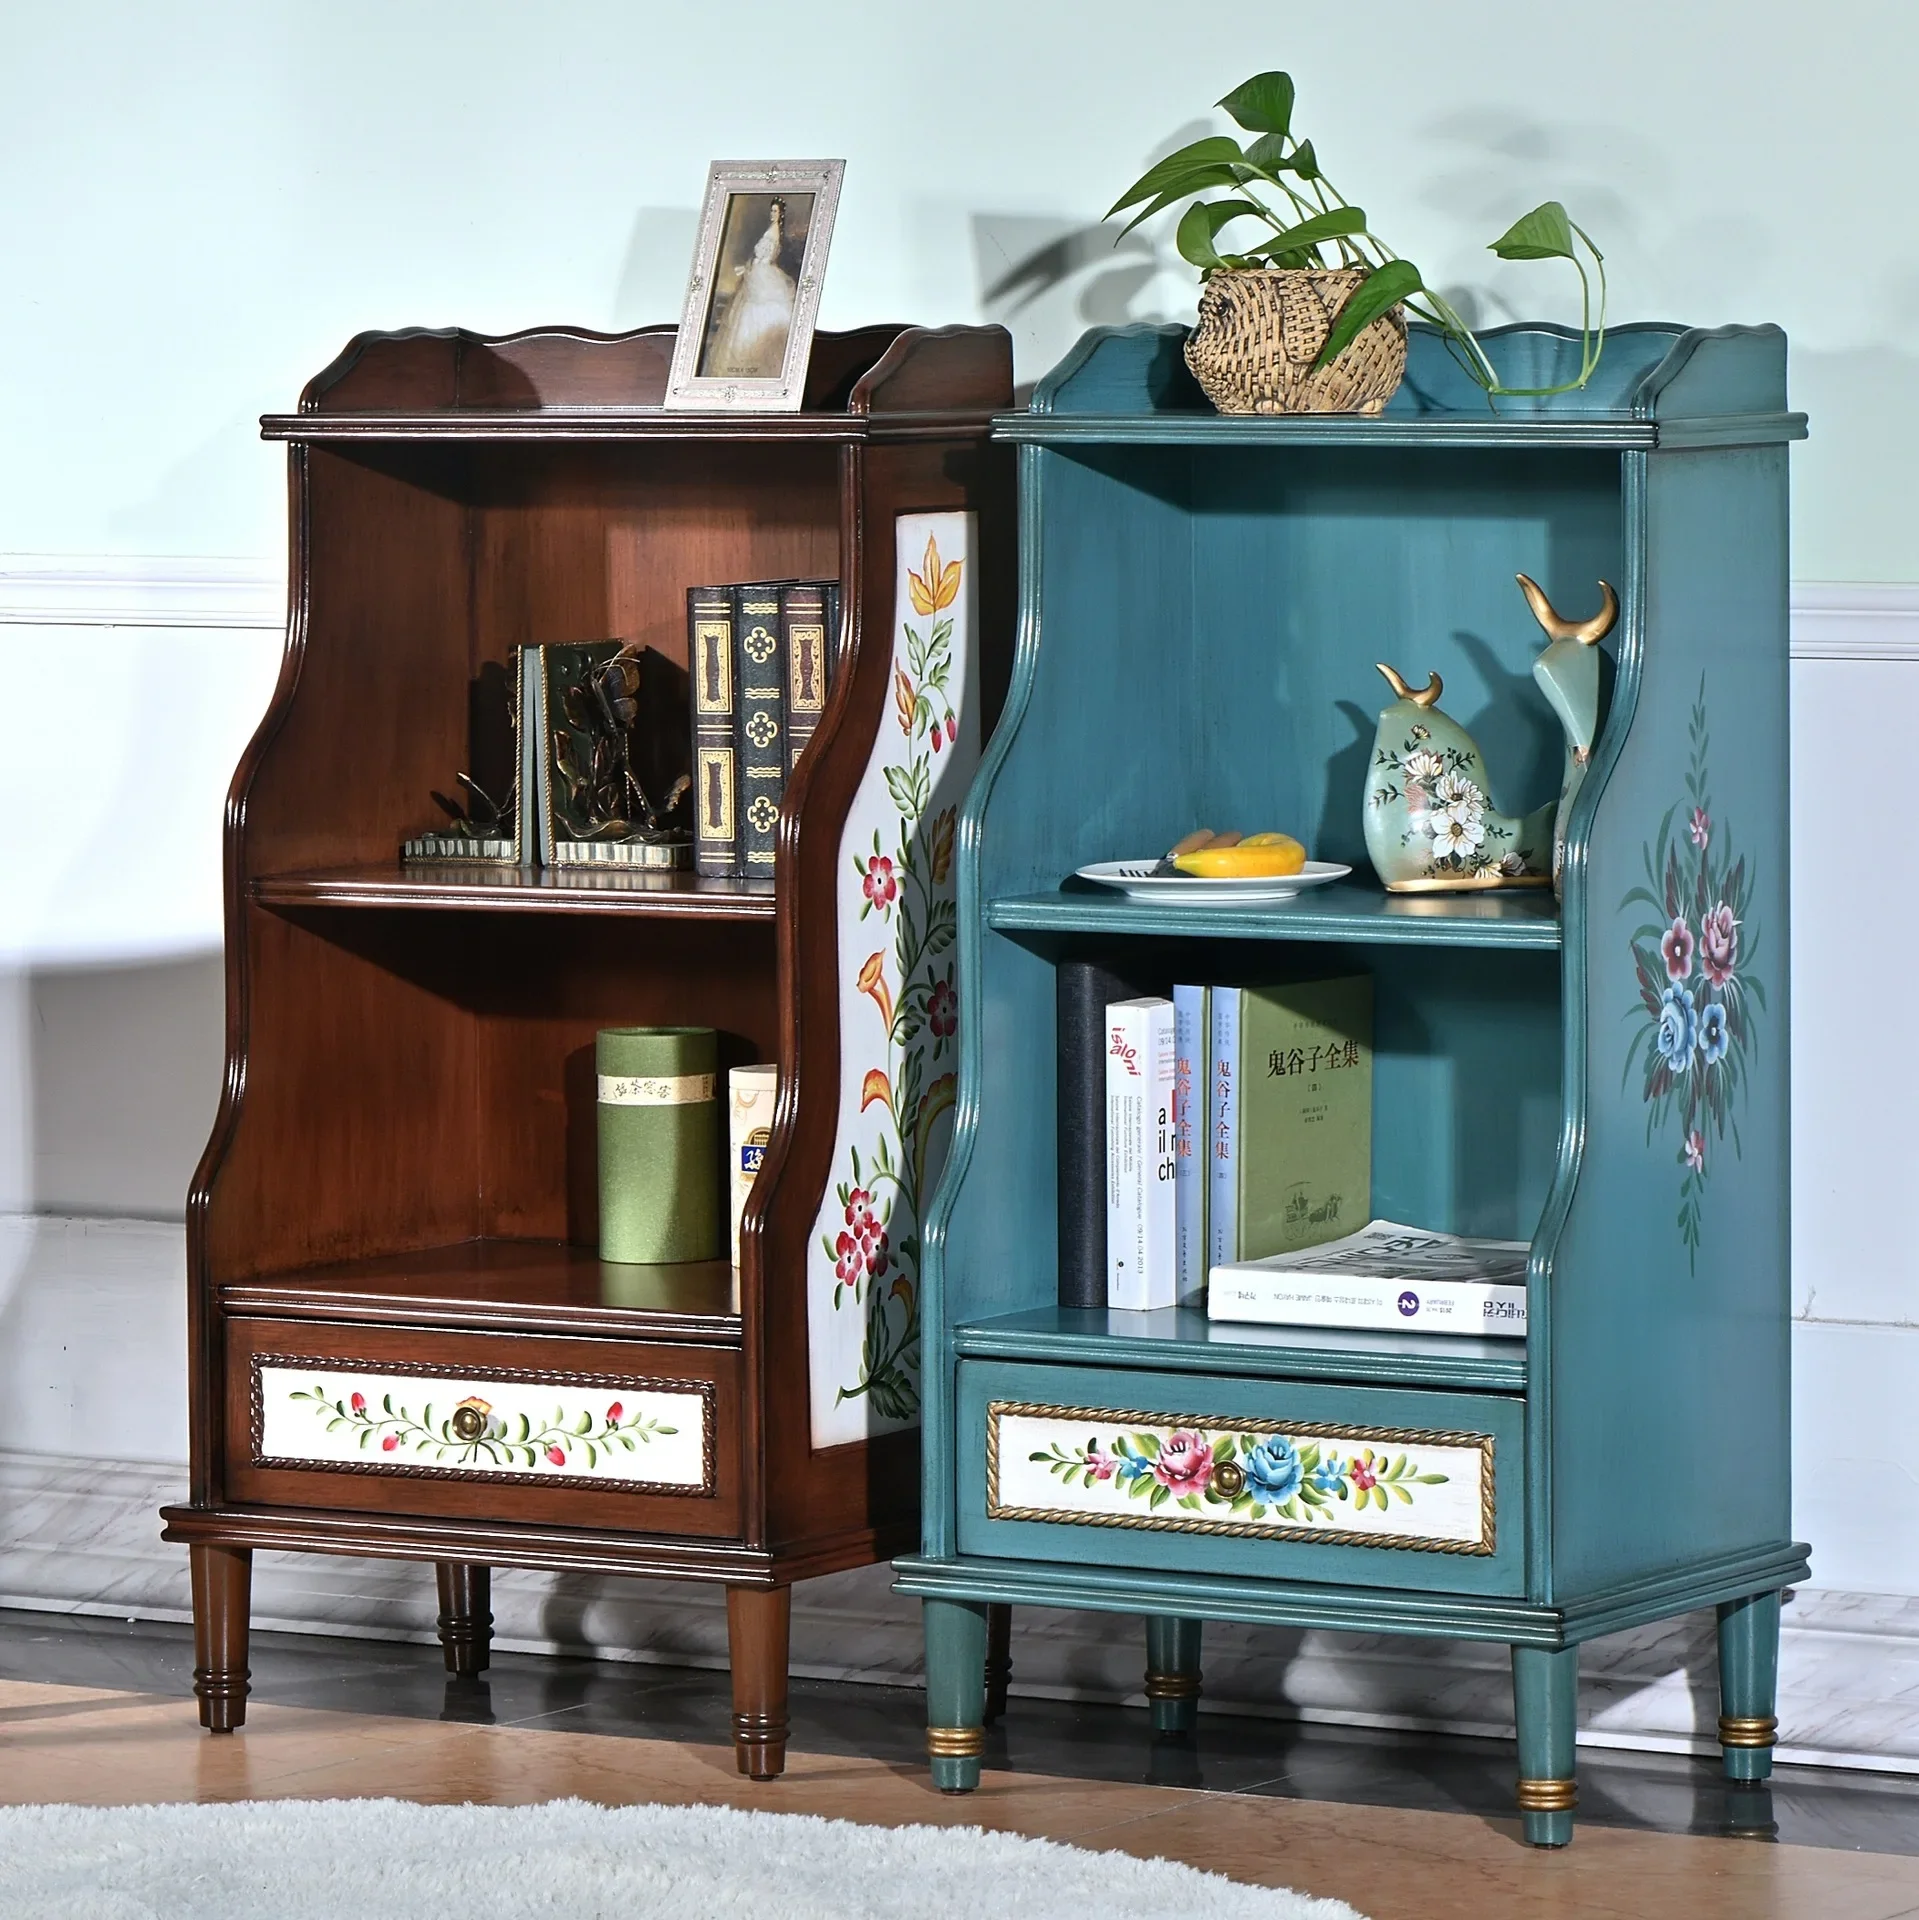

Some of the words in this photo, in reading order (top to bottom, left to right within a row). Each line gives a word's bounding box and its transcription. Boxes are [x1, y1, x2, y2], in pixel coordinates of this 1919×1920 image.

[1268, 1041, 1359, 1078] 鬼谷子全集
[1159, 1107, 1167, 1126] a
[1177, 1057, 1193, 1158] 鬼谷子全集
[1216, 1060, 1232, 1160] 鬼谷子全集
[1159, 1130, 1166, 1154] il
